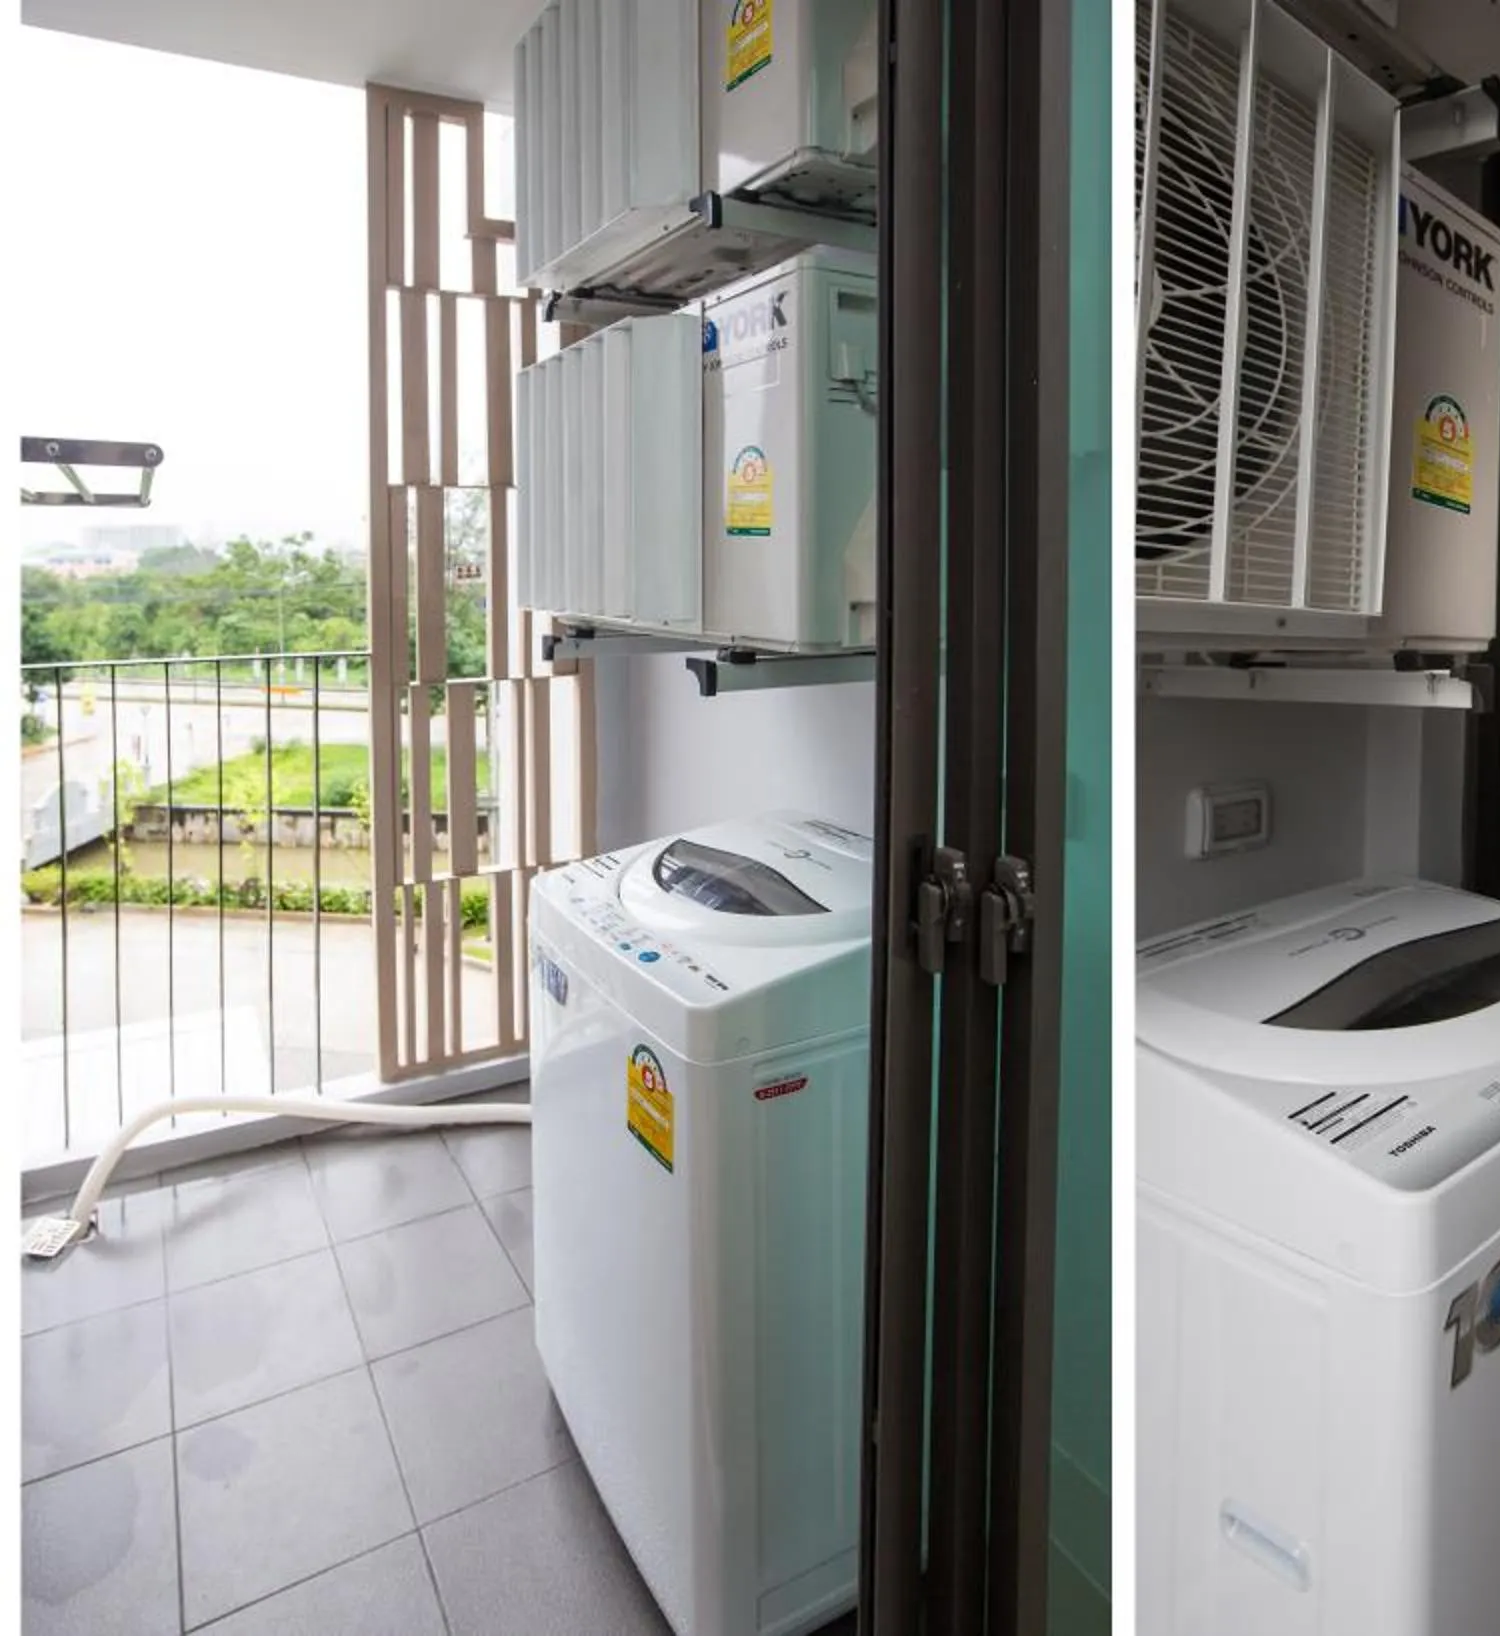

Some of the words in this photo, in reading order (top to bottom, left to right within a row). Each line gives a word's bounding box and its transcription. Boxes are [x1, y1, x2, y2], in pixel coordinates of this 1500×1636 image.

[1408, 199, 1495, 293] YORK
[719, 290, 789, 347] YORK
[1387, 1125, 1437, 1157] TOSHIBA
